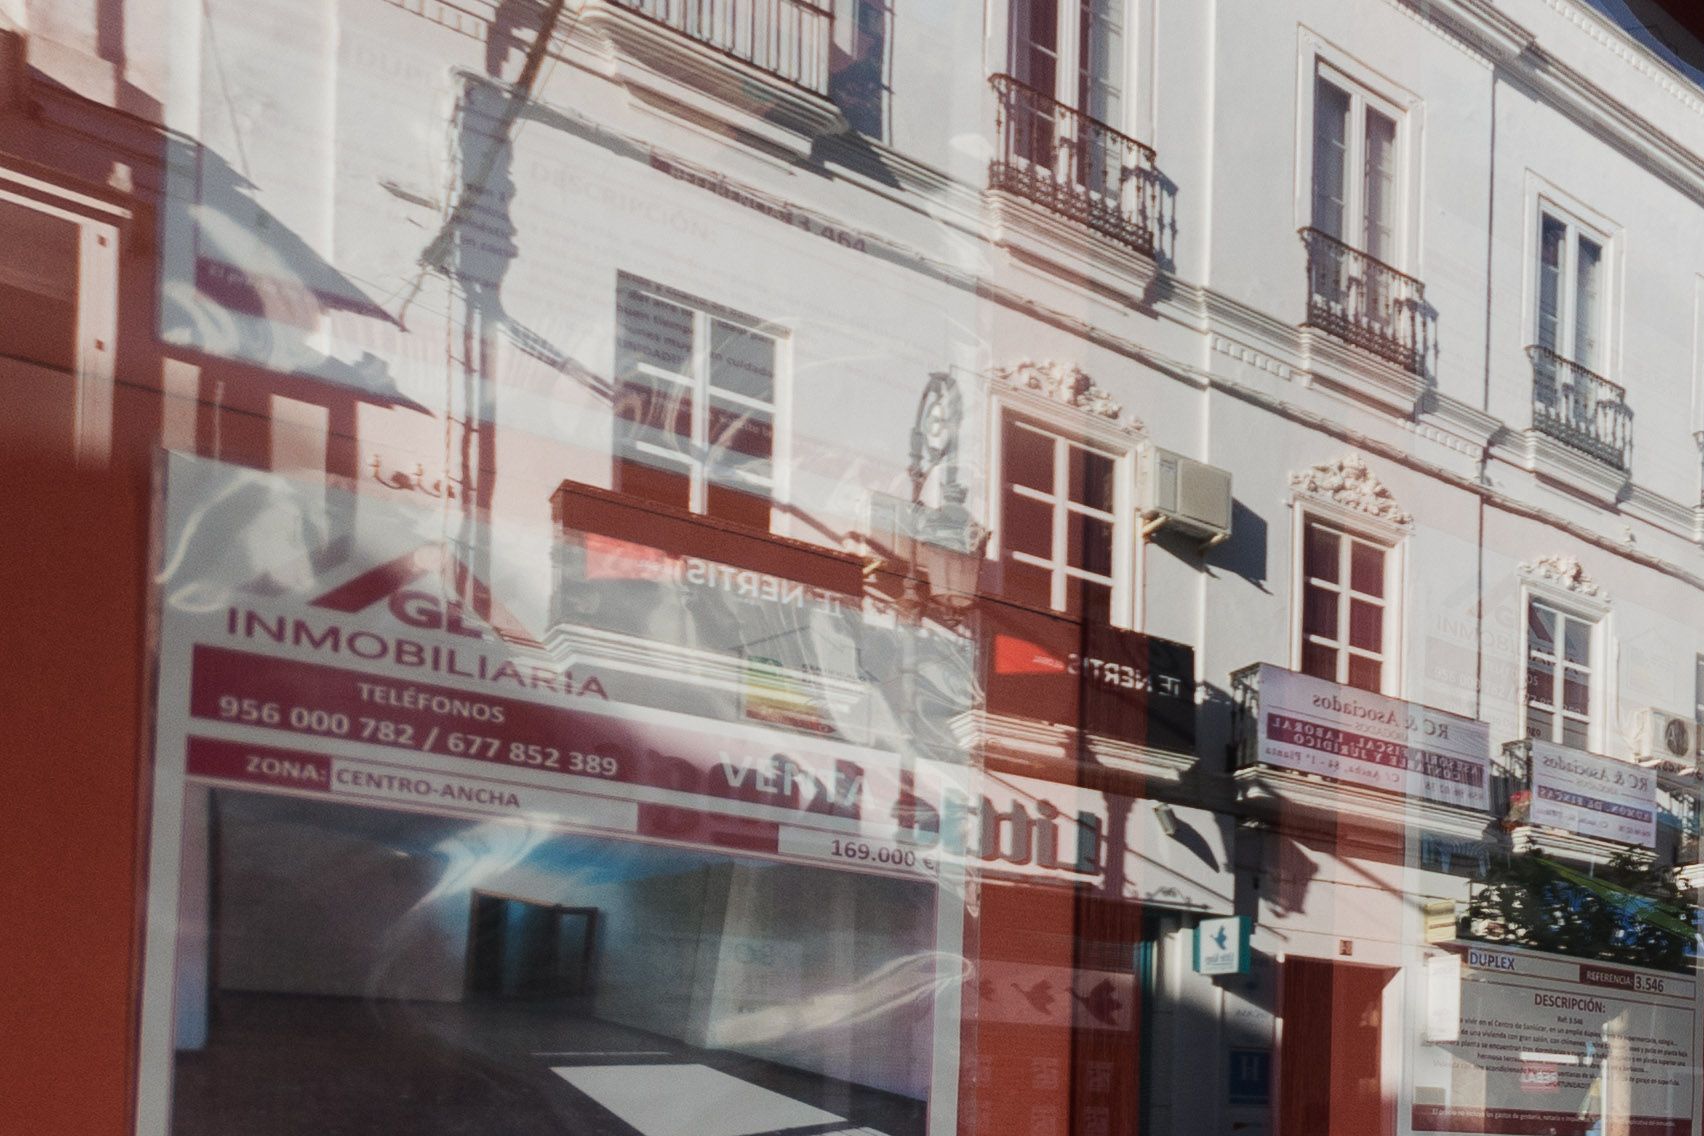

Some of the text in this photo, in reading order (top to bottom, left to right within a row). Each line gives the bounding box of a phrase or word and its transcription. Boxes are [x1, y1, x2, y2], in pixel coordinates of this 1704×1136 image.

[388, 589, 484, 640] GL
[227, 607, 610, 701] INMOBILIARIA
[358, 682, 505, 723] TELÉFONOS
[218, 695, 619, 778] 956 000 782 / 677 852 389
[719, 751, 876, 811] VENTA
[246, 754, 328, 783] ZONA:
[336, 768, 520, 809] CENTRO-ANCHA
[830, 839, 917, 870] 169.000
[1469, 952, 1665, 993] DUPLEX REFERENCIA: 3.546
[1534, 993, 1607, 1013] DESCRIPCIÓN:
